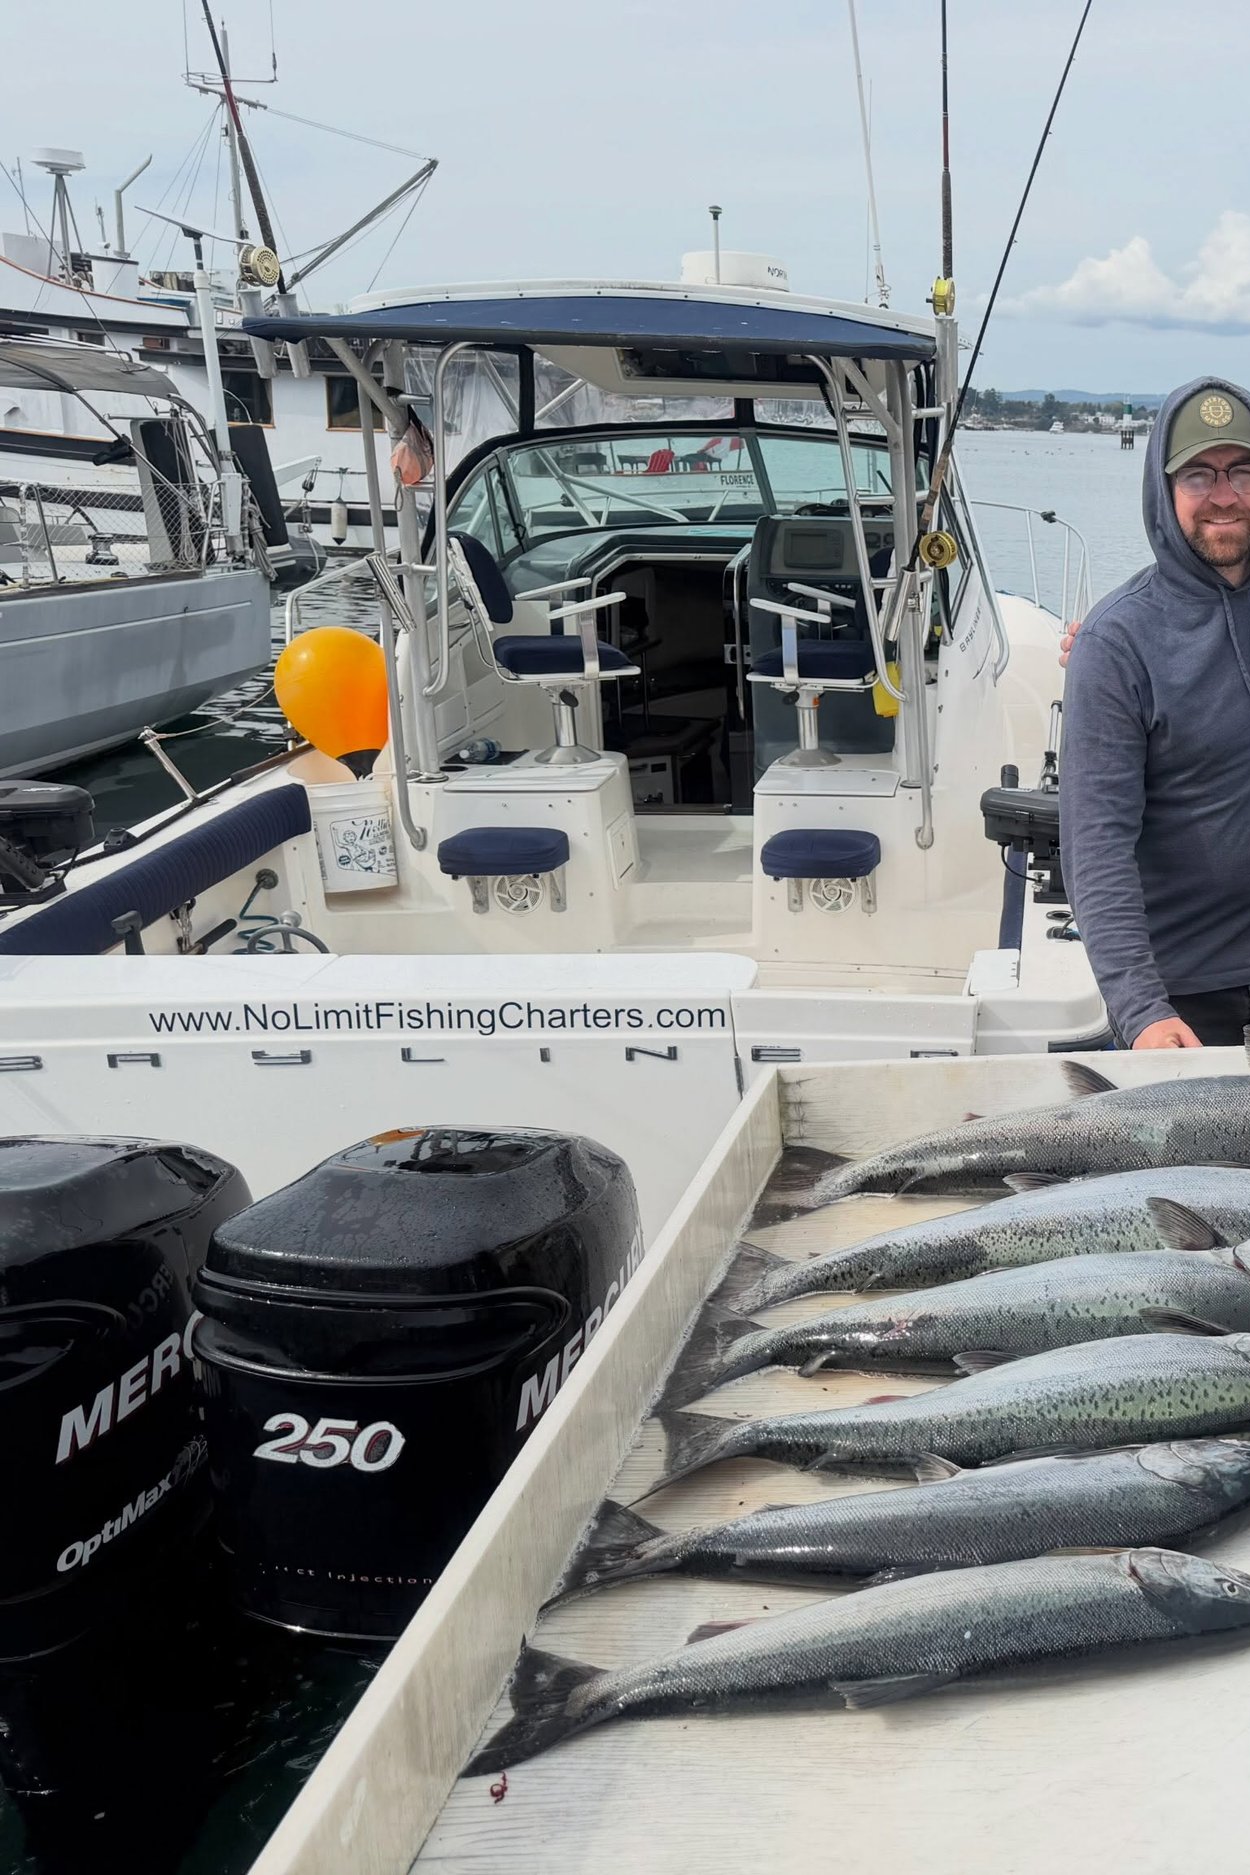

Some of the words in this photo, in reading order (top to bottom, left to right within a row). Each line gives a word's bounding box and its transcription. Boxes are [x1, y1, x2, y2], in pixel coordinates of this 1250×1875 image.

[720, 474, 755, 486] FLORENCE
[148, 1001, 726, 1036] www.NoLimitFishingCharters.com
[252, 1412, 406, 1473] 250
[56, 1471, 172, 1572] OptiMax
